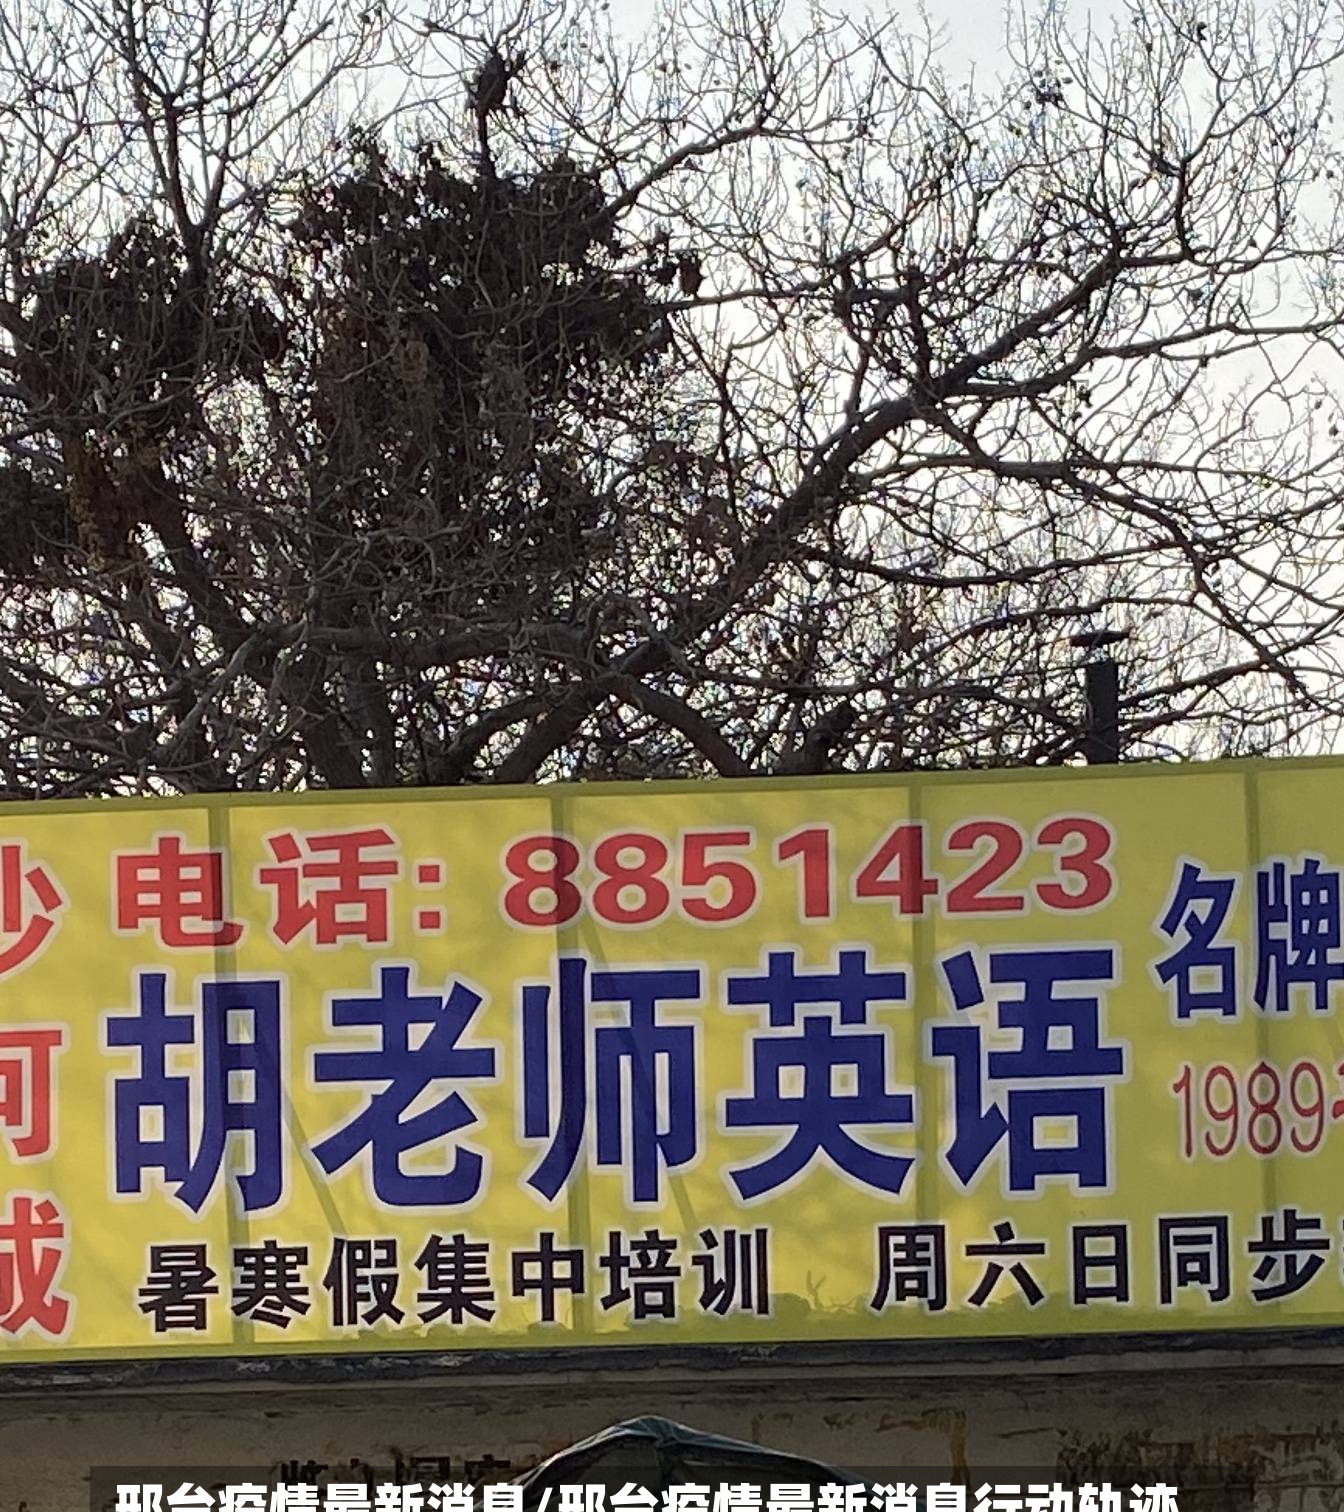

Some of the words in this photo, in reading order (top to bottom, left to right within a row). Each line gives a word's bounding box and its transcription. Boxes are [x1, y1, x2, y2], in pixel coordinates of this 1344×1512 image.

[503, 818, 1114, 928] 8851423
[106, 948, 1124, 1212] 胡老师英语
[137, 1227, 771, 1334] 暑寒假集中培训
